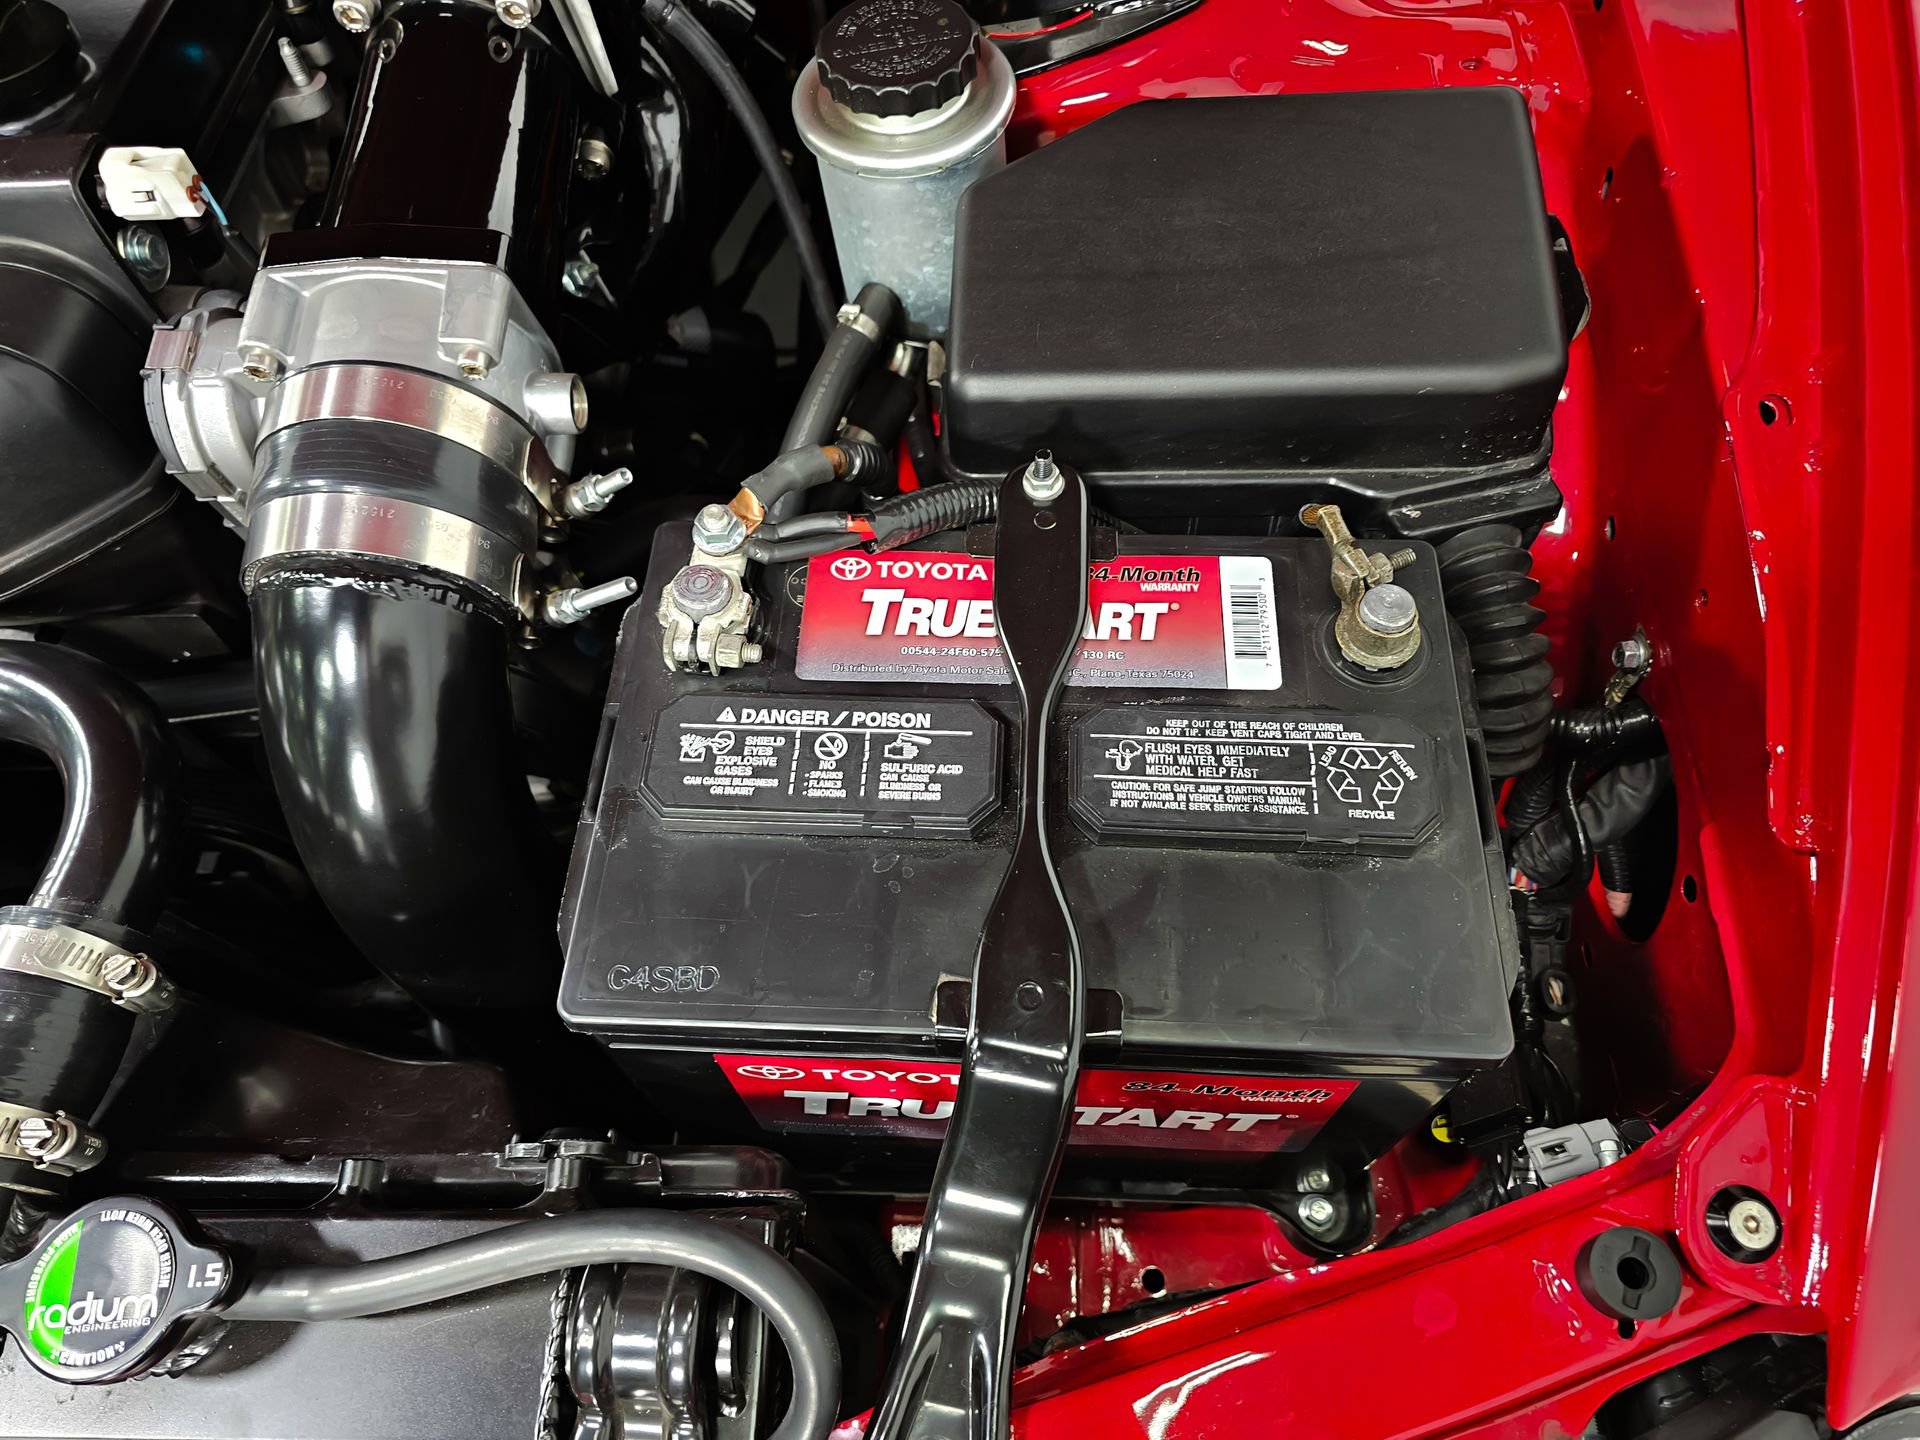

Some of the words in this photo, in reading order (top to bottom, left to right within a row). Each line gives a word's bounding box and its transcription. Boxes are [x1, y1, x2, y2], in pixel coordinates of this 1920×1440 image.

[876, 561, 988, 581] TOYOTA
[1140, 583, 1199, 592] WARRANTY
[1083, 650, 1104, 659] 130
[1107, 650, 1124, 660] RC
[832, 663, 892, 674] Distributed
[896, 664, 909, 675] by
[910, 665, 947, 675] Toyota
[950, 665, 983, 675] Motor
[1126, 669, 1157, 679] Texas
[1161, 670, 1194, 680] 75024
[740, 708, 830, 725] DANGER
[851, 712, 931, 728] POISON
[1166, 719, 1189, 727] KEEP
[1192, 720, 1211, 728] OUT
[1229, 721, 1248, 729] THE
[1250, 721, 1280, 730] REACH
[1282, 722, 1297, 731] OF
[1299, 723, 1343, 732] CHILDREN
[1146, 727, 1159, 735] DO
[1162, 728, 1182, 736] NOT
[1184, 728, 1201, 736] TIP.
[1205, 729, 1229, 737] KEEP
[1231, 729, 1255, 738] VENT
[1257, 730, 1282, 738] CAPS
[1284, 731, 1312, 739] TIGHT
[1314, 732, 1334, 740] AND
[1337, 732, 1365, 741] LEVEL
[745, 736, 785, 746] SHIELD
[744, 746, 773, 756] EYES
[1145, 743, 1181, 754] FLUSH
[1184, 744, 1213, 755] EYES
[1215, 745, 1290, 757] IMMEDIATELY
[1319, 745, 1337, 767] LEAD
[715, 756, 777, 767] EXPLOSIVE
[819, 760, 836, 770] NO
[1146, 754, 1175, 765] WITH
[1223, 757, 1244, 767] GET
[1388, 749, 1418, 782] RETURN
[714, 766, 752, 775] GASES
[809, 771, 843, 780] SPARKS
[880, 763, 936, 774] SULFURIC
[938, 764, 963, 775] ACID
[1146, 765, 1195, 776] MEDICAL
[1198, 766, 1227, 778] HELP
[1230, 768, 1259, 779] FAST
[683, 776, 701, 784] CAN
[703, 777, 731, 786] CAUSE
[733, 778, 779, 787] BLINDNESS
[808, 780, 842, 788] FLAMES
[880, 773, 898, 781] CAN
[901, 774, 929, 782] CAUSE
[710, 786, 722, 794] OR
[723, 786, 755, 796] INJURY
[807, 788, 846, 797] SMOKING
[879, 782, 925, 791] BLINDNESS
[928, 783, 942, 792] OR
[1153, 782, 1171, 791] FOR
[1173, 783, 1195, 792] SAFE
[1198, 784, 1222, 793] JUMP
[1224, 785, 1267, 795] STARTING
[1269, 786, 1306, 796] FOLLOW
[878, 791, 911, 800] SEVERE
[912, 792, 941, 800] BURNS
[1112, 790, 1175, 800] INSTRUCTIONS
[1178, 792, 1186, 801] IN
[1188, 792, 1225, 802] VEHICLE
[1227, 793, 1265, 804] OWNERS
[1110, 799, 1118, 807] IF
[1119, 799, 1139, 808] NOT
[1141, 800, 1187, 810] AVAILABLE
[1188, 801, 1212, 811] SEEK
[1213, 802, 1251, 812] SERVICE
[1253, 803, 1309, 815] ASSISTANCE.
[1348, 809, 1395, 820] RECYCLE
[811, 1068, 961, 1085] TOYOT
[1121, 1081, 1334, 1099] 84-Month
[1240, 1096, 1326, 1104] WARRANTY
[124, 1211, 154, 1232] WHEN
[149, 1226, 168, 1252] OPEN
[158, 1251, 172, 1288] NEVER
[187, 1262, 223, 1288] 1.5
[28, 1291, 158, 1331] radium
[63, 1317, 151, 1335] ENGINEERING
[59, 1344, 115, 1366] CAUTION
